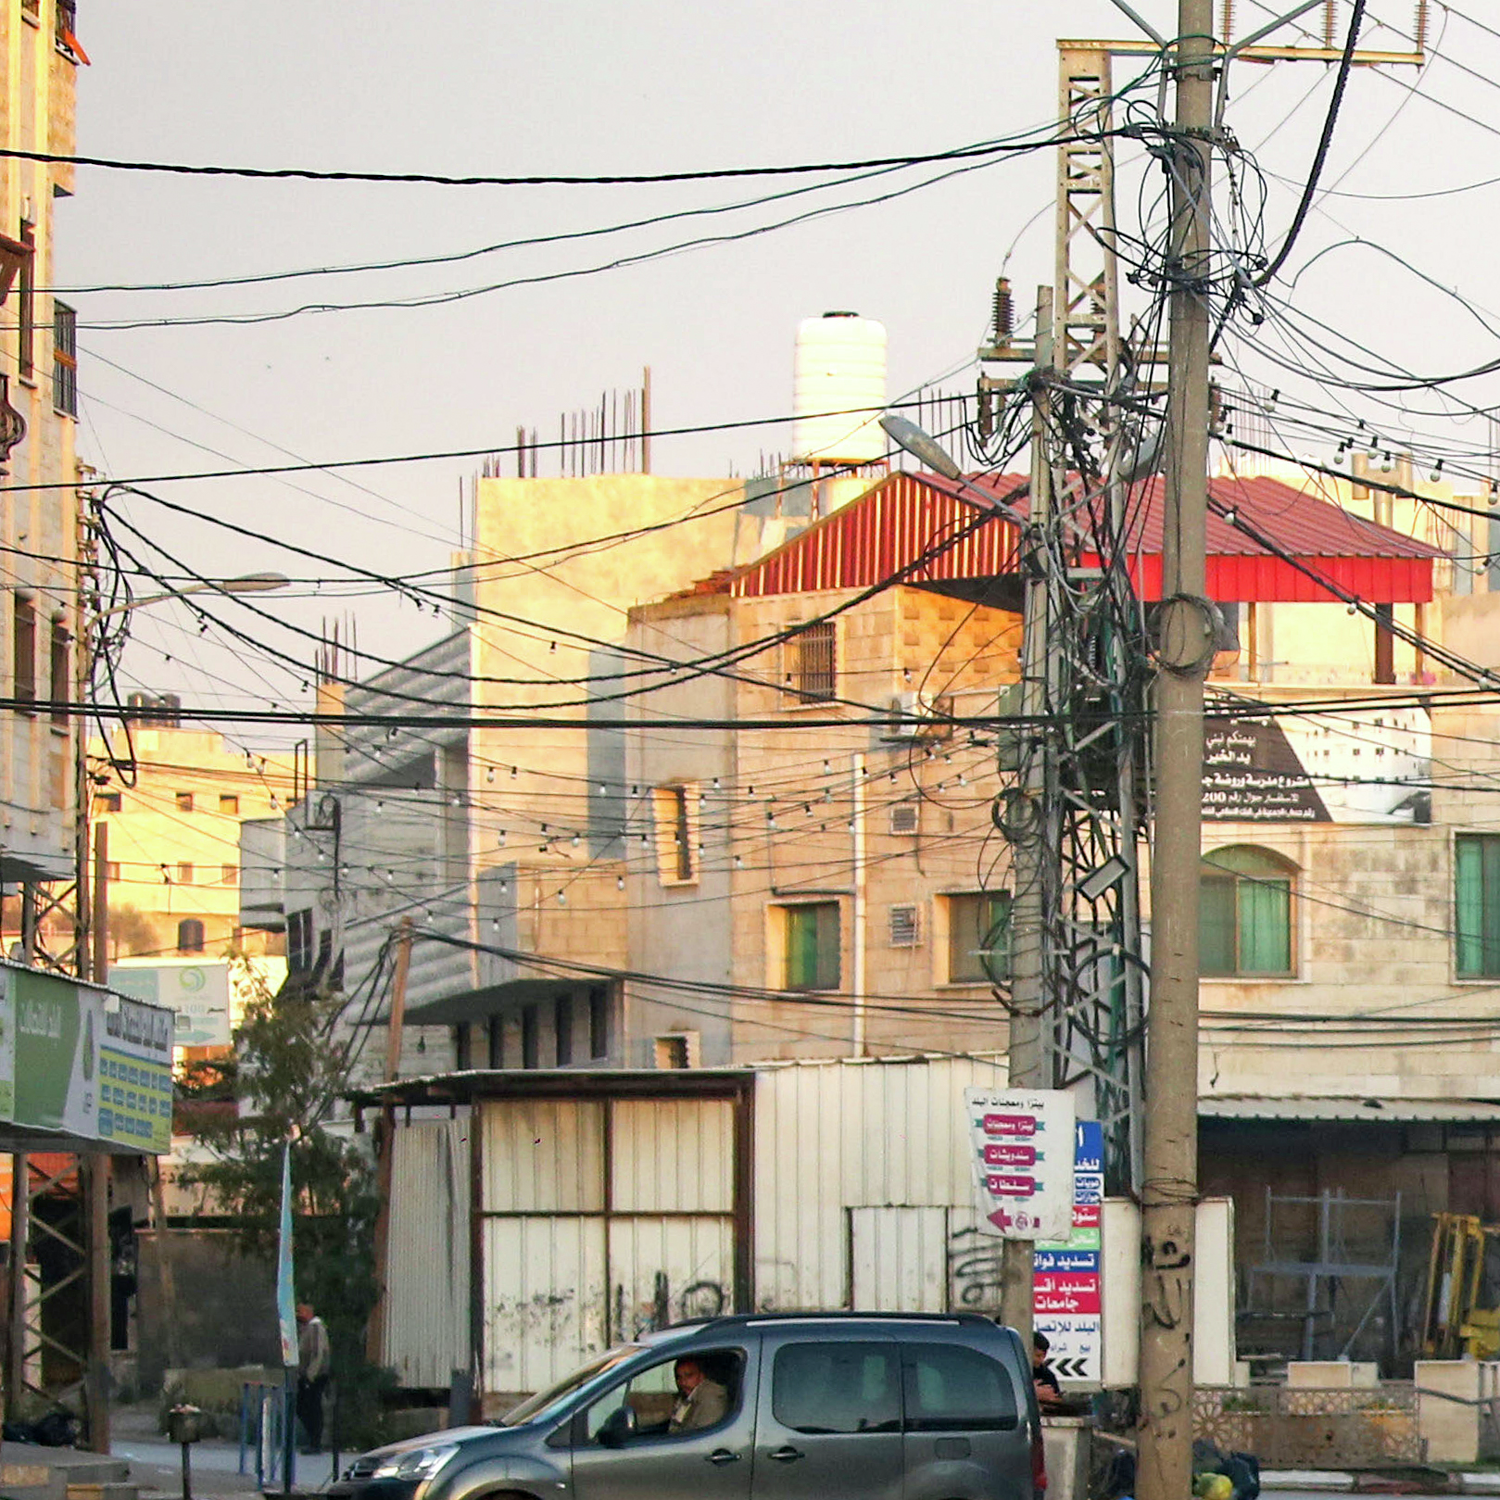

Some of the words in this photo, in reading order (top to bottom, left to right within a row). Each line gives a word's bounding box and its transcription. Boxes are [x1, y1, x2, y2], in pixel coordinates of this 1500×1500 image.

[990, 1148, 1030, 1162] سندويشات
[990, 1177, 1030, 1191] سلطات
[1057, 1253, 1095, 1270] تسديد
[1058, 1279, 1096, 1295] تسديد
[1035, 1295, 1079, 1312] جامعات
[1075, 1321, 1100, 1335] البلد
